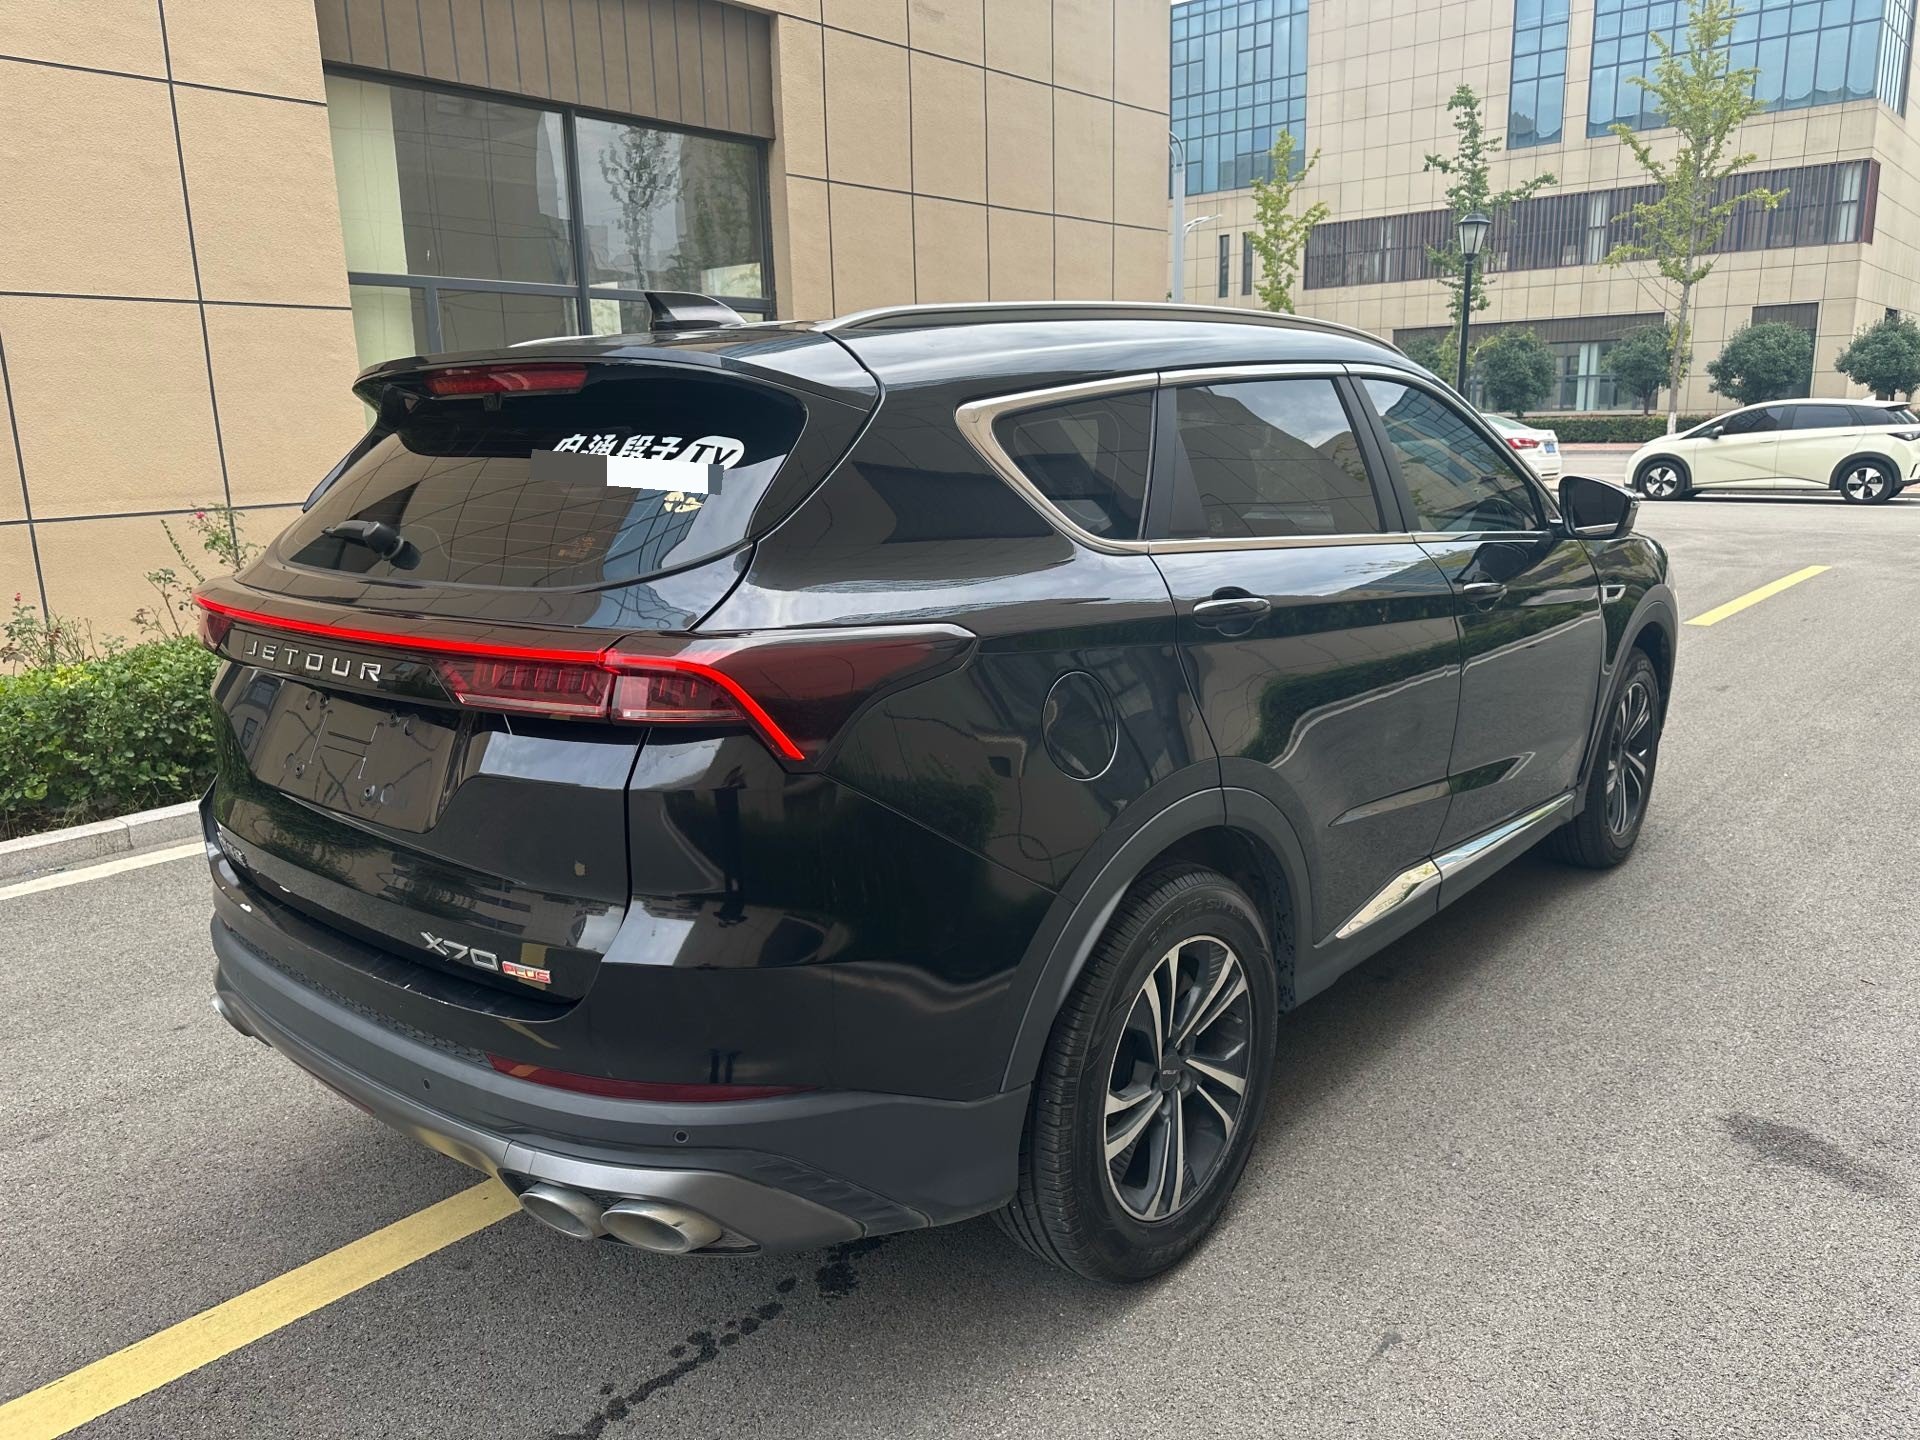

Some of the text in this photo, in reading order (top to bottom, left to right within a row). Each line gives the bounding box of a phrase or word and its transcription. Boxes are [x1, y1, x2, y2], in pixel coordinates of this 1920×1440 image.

[689, 443, 739, 465] TV
[245, 640, 382, 682] JETOUR
[420, 931, 551, 984] X70 PLUS
